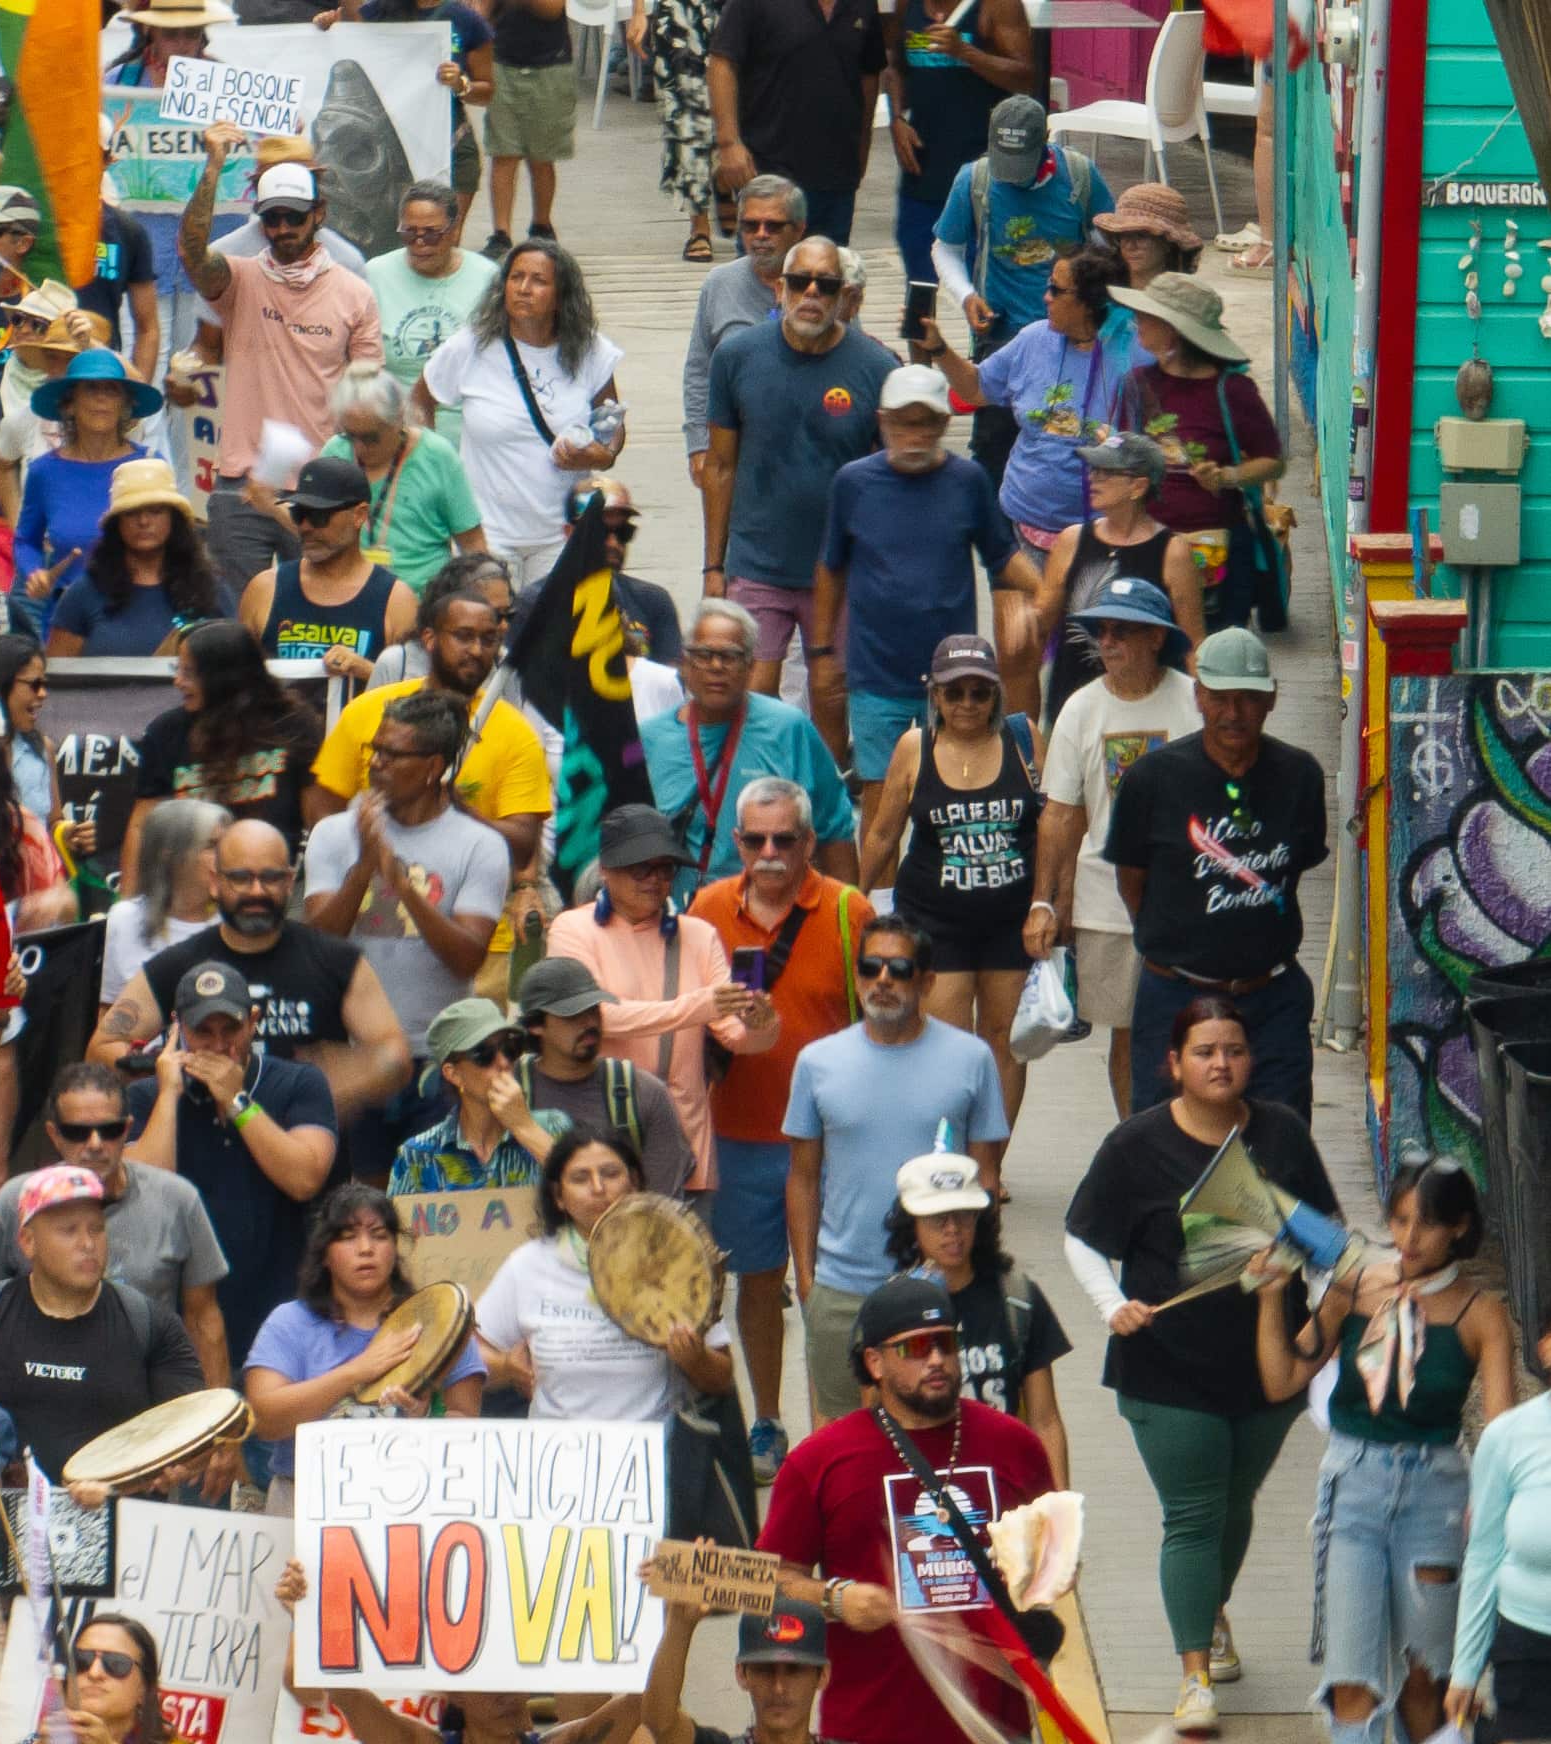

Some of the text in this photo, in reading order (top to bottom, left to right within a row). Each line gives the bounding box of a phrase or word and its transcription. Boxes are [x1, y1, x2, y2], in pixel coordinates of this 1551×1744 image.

[196, 65, 215, 93] al
[223, 67, 301, 104] BOSQUE
[198, 102, 209, 119] a
[947, 798, 1024, 824] PUEBLO
[940, 857, 1025, 891] PUEBLO
[412, 1198, 513, 1238] NO A
[25, 1361, 86, 1381] VICTORY
[307, 1428, 654, 1526] ¡ESENCIA
[174, 1527, 276, 1620] MAR
[319, 1520, 651, 1676] NO VA!
[157, 1609, 262, 1694] TIERRA
